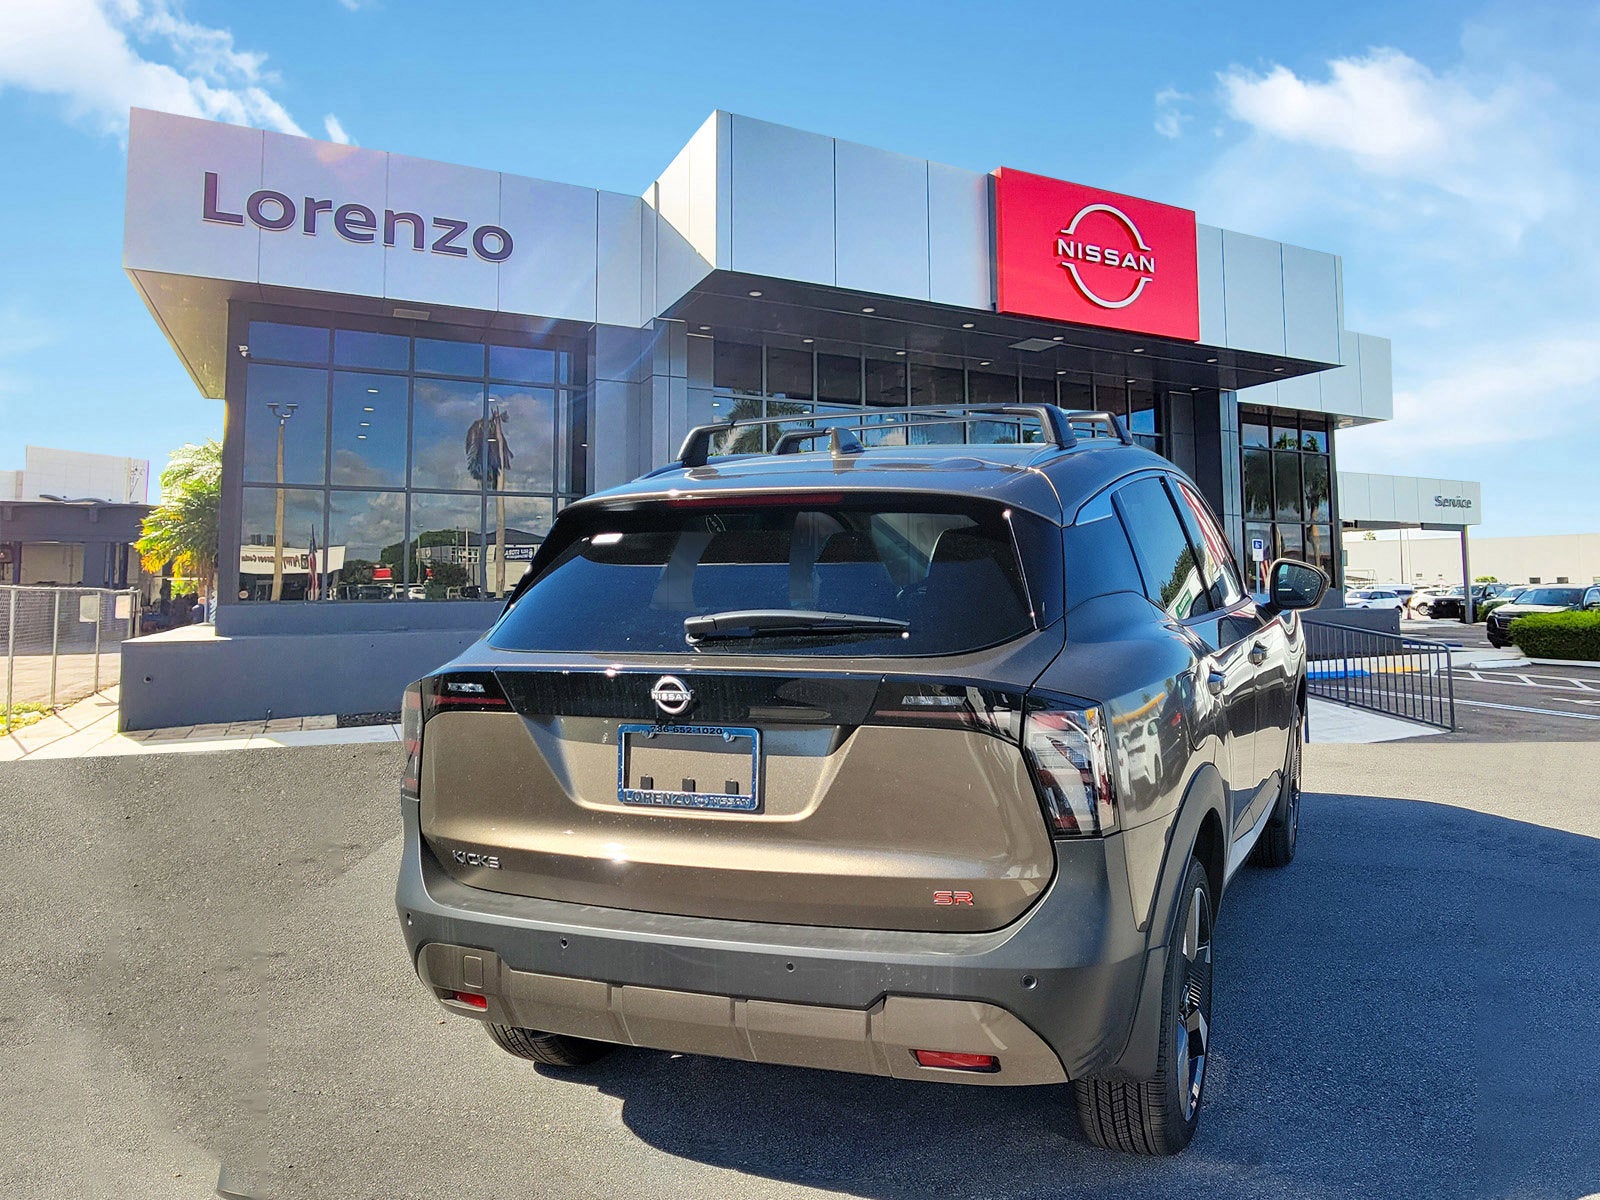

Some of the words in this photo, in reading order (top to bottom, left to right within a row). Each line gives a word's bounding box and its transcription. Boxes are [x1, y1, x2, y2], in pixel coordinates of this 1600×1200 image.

[202, 170, 514, 263] Lorenzo
[1057, 238, 1156, 273] NISSAN
[1434, 495, 1472, 508] Service
[651, 690, 691, 701] NISSAN
[624, 791, 693, 805] LORENZO
[452, 850, 500, 868] KICKS
[933, 891, 974, 906] SR
